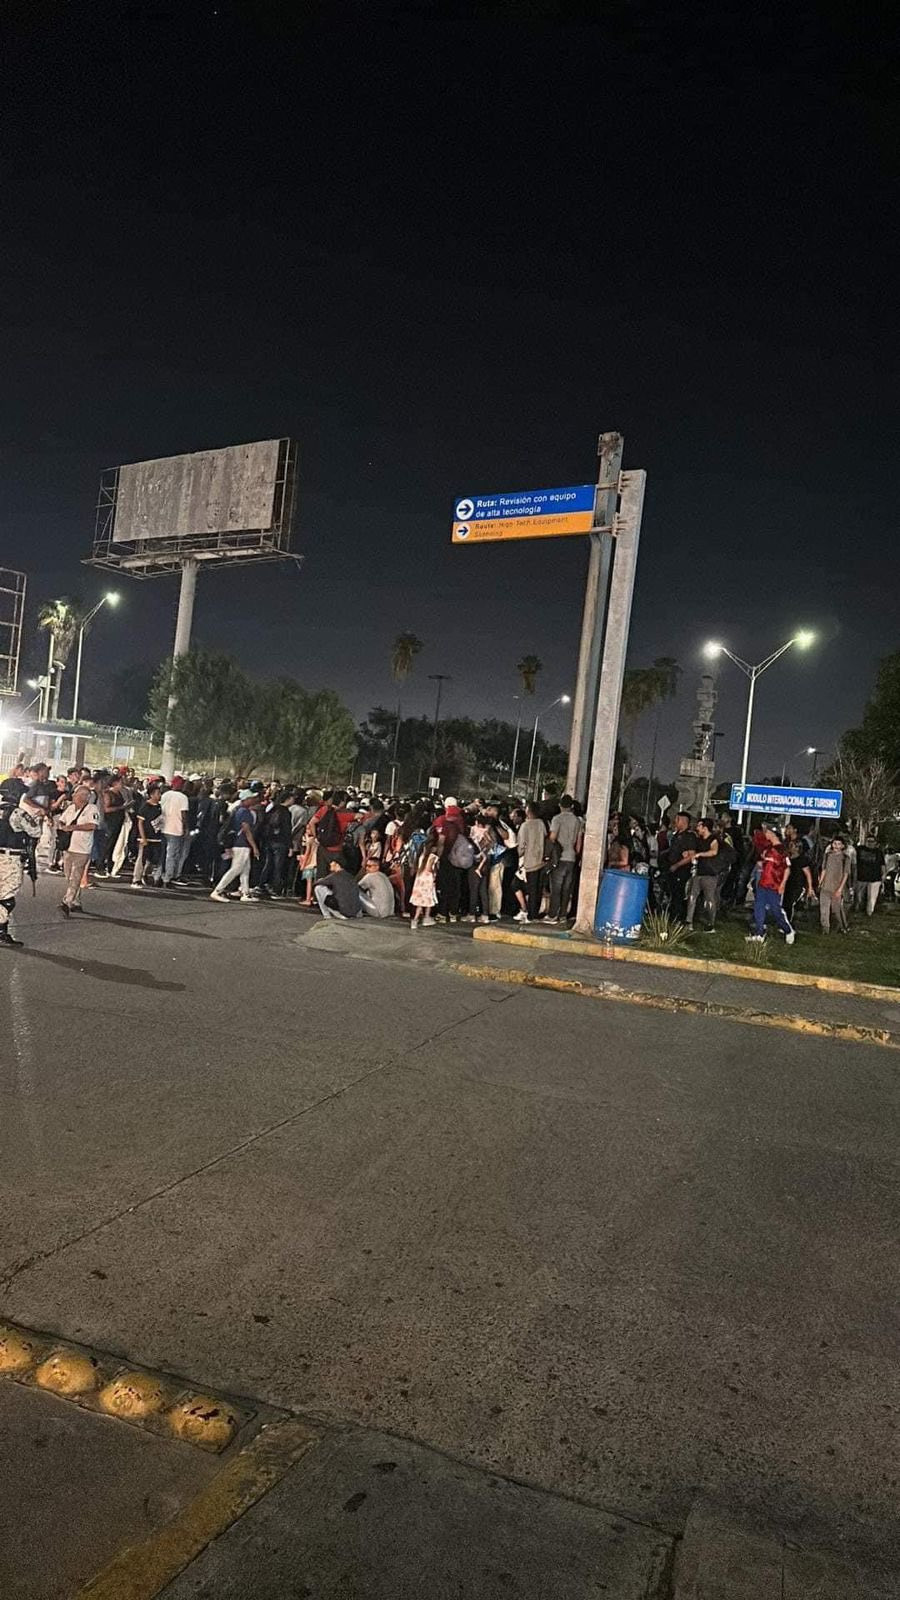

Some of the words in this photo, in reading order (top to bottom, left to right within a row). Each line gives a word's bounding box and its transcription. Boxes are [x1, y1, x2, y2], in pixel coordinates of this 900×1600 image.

[477, 499, 497, 508] Ruta:
[549, 492, 577, 502] equipo
[486, 508, 501, 517] alta
[767, 794, 805, 807] INTERNACIONAL
[806, 797, 814, 807] DE
[814, 797, 838, 808] TURISMO
